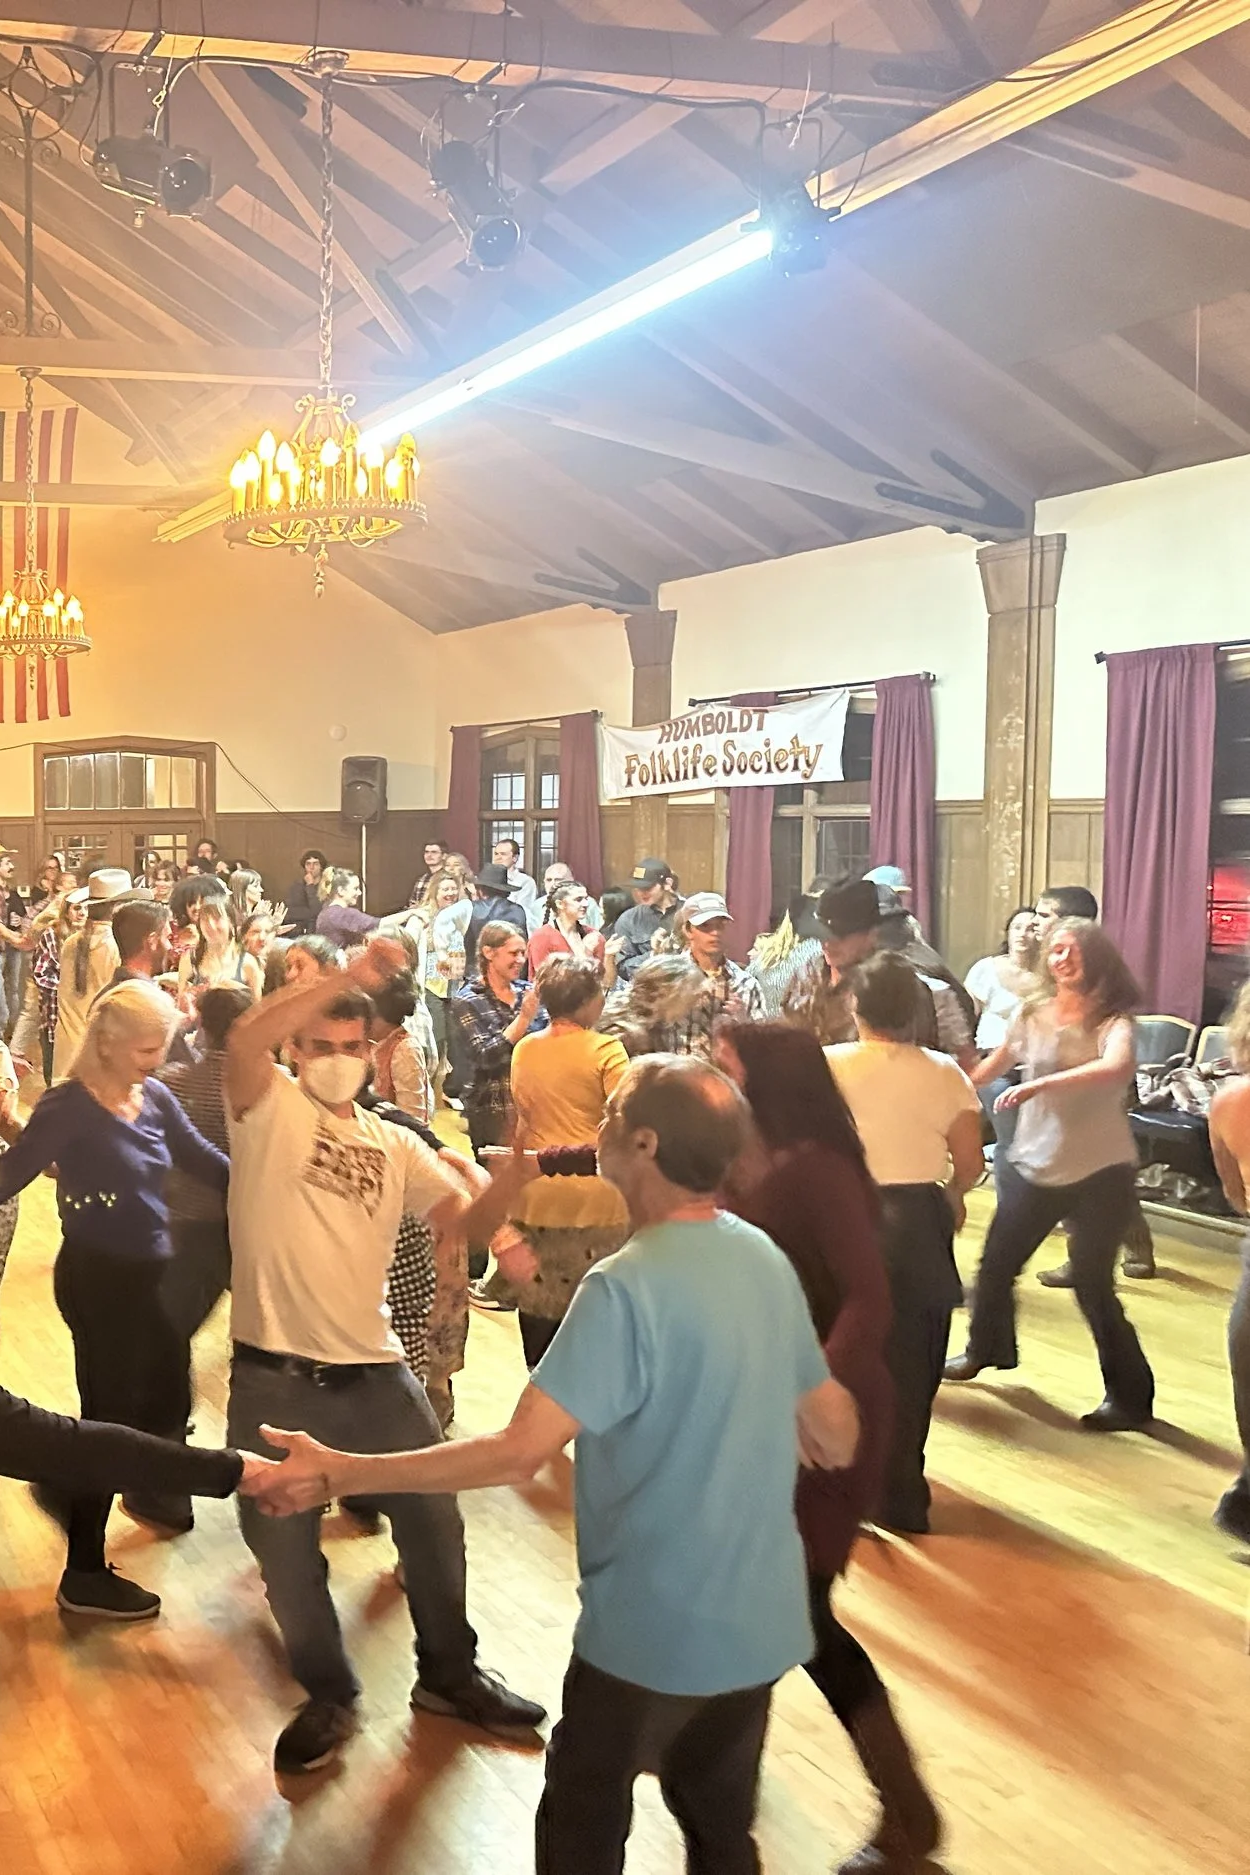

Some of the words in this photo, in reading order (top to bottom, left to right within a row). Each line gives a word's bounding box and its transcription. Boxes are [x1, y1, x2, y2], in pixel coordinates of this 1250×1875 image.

[659, 709, 769, 744] HUMBOLDT
[625, 744, 717, 787] Folklife
[723, 734, 823, 779] Society
